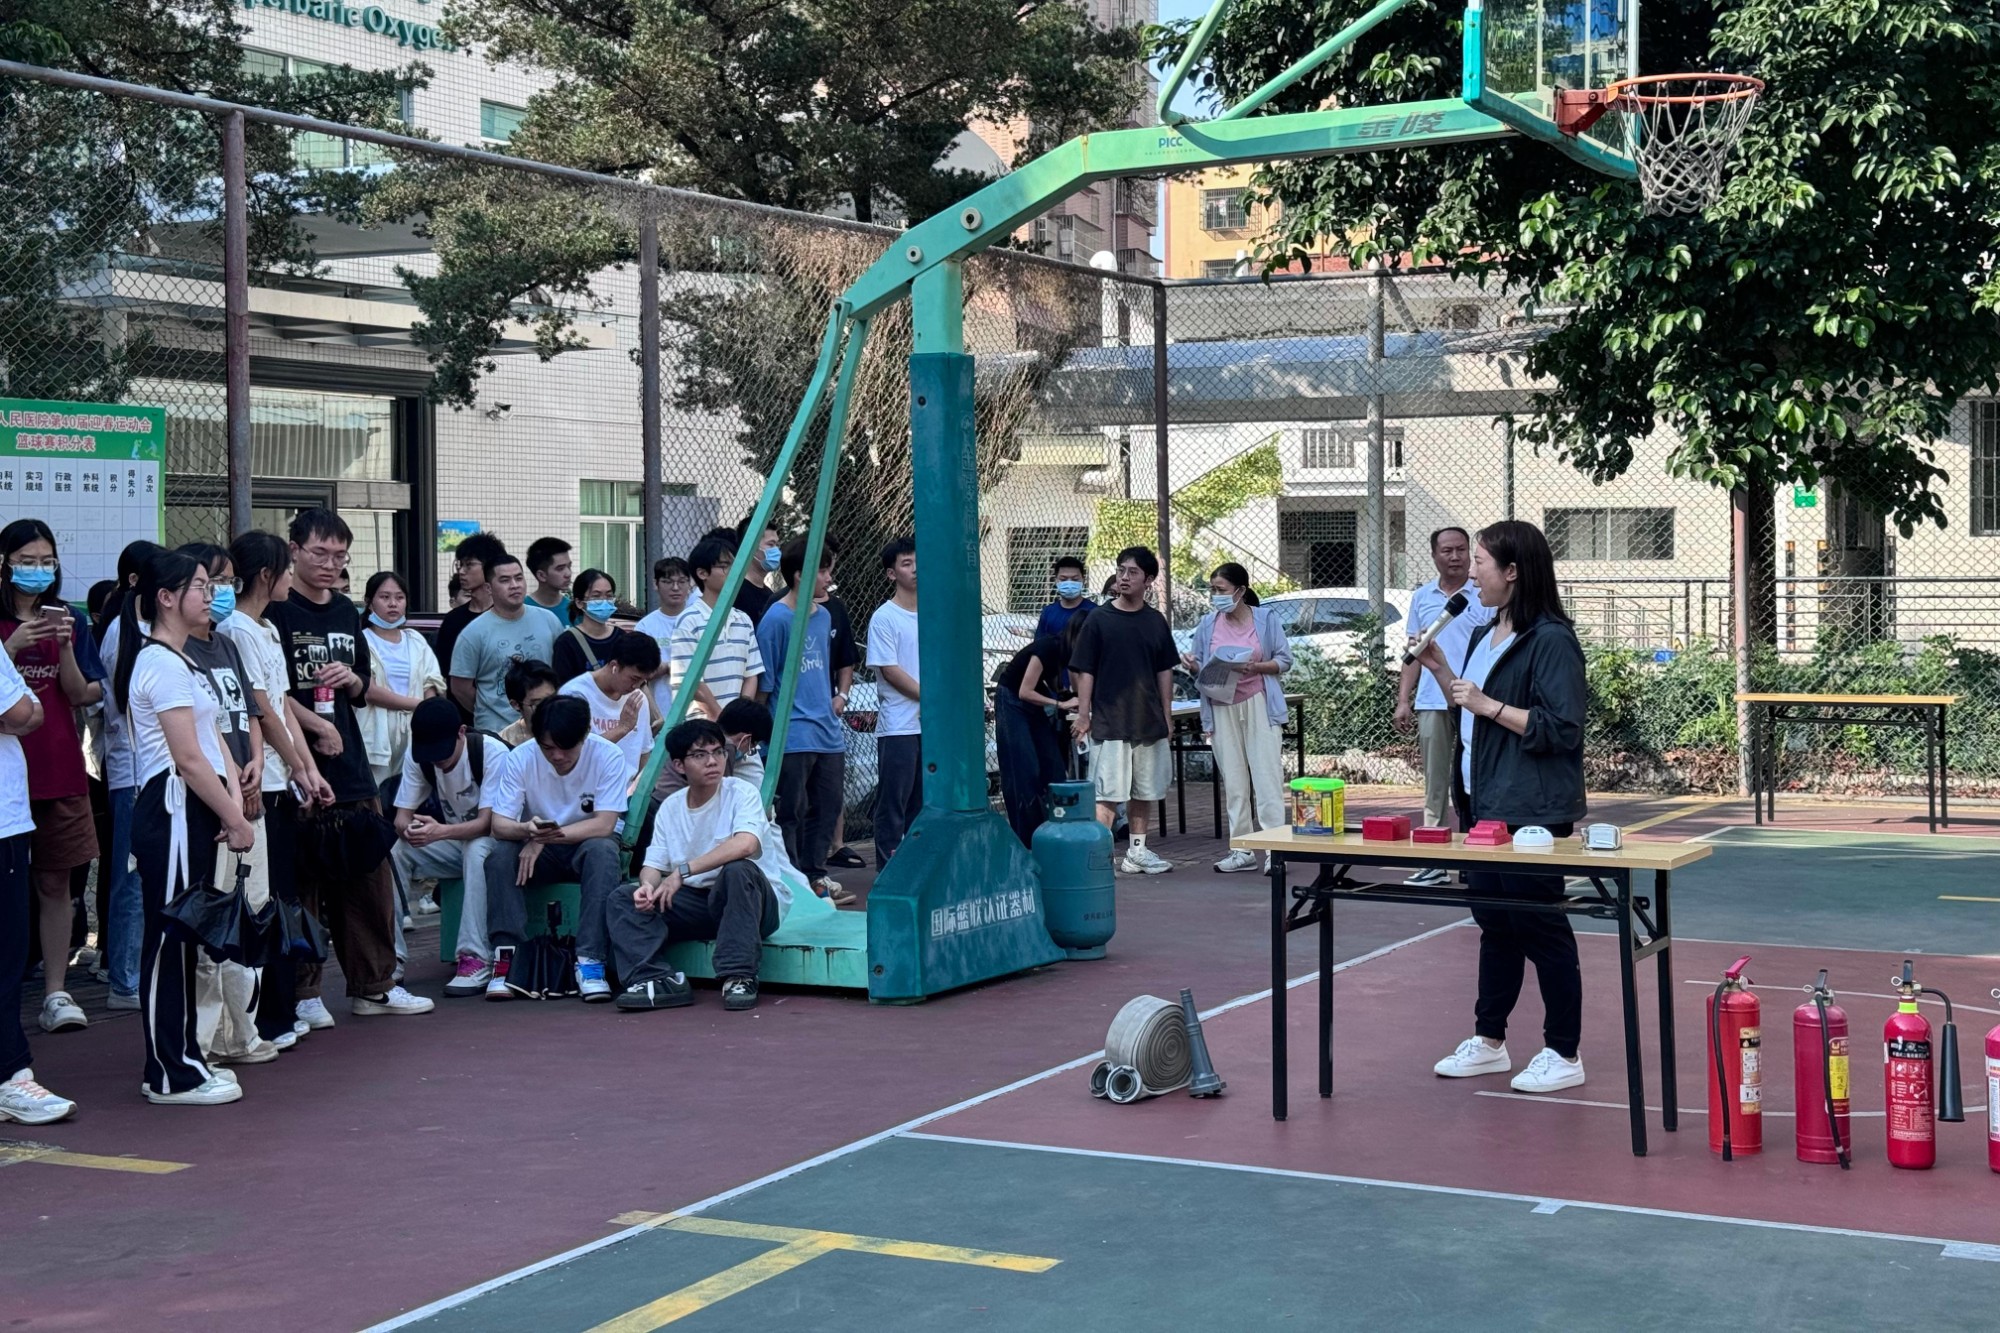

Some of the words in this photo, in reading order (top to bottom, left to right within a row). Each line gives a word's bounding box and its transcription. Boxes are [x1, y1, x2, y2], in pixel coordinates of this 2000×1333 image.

[1358, 111, 1447, 137] 金陵
[1159, 137, 1183, 148] PICC
[16, 432, 96, 452] 篮球赛积分表
[25, 471, 43, 481] 实习
[55, 472, 72, 482] 行政
[83, 473, 99, 482] 外科
[55, 483, 72, 492] 医技
[83, 484, 99, 493] 系统
[110, 474, 118, 492] 积分
[146, 475, 153, 493] 名次
[931, 887, 1036, 937] 国际篮联认证器材
